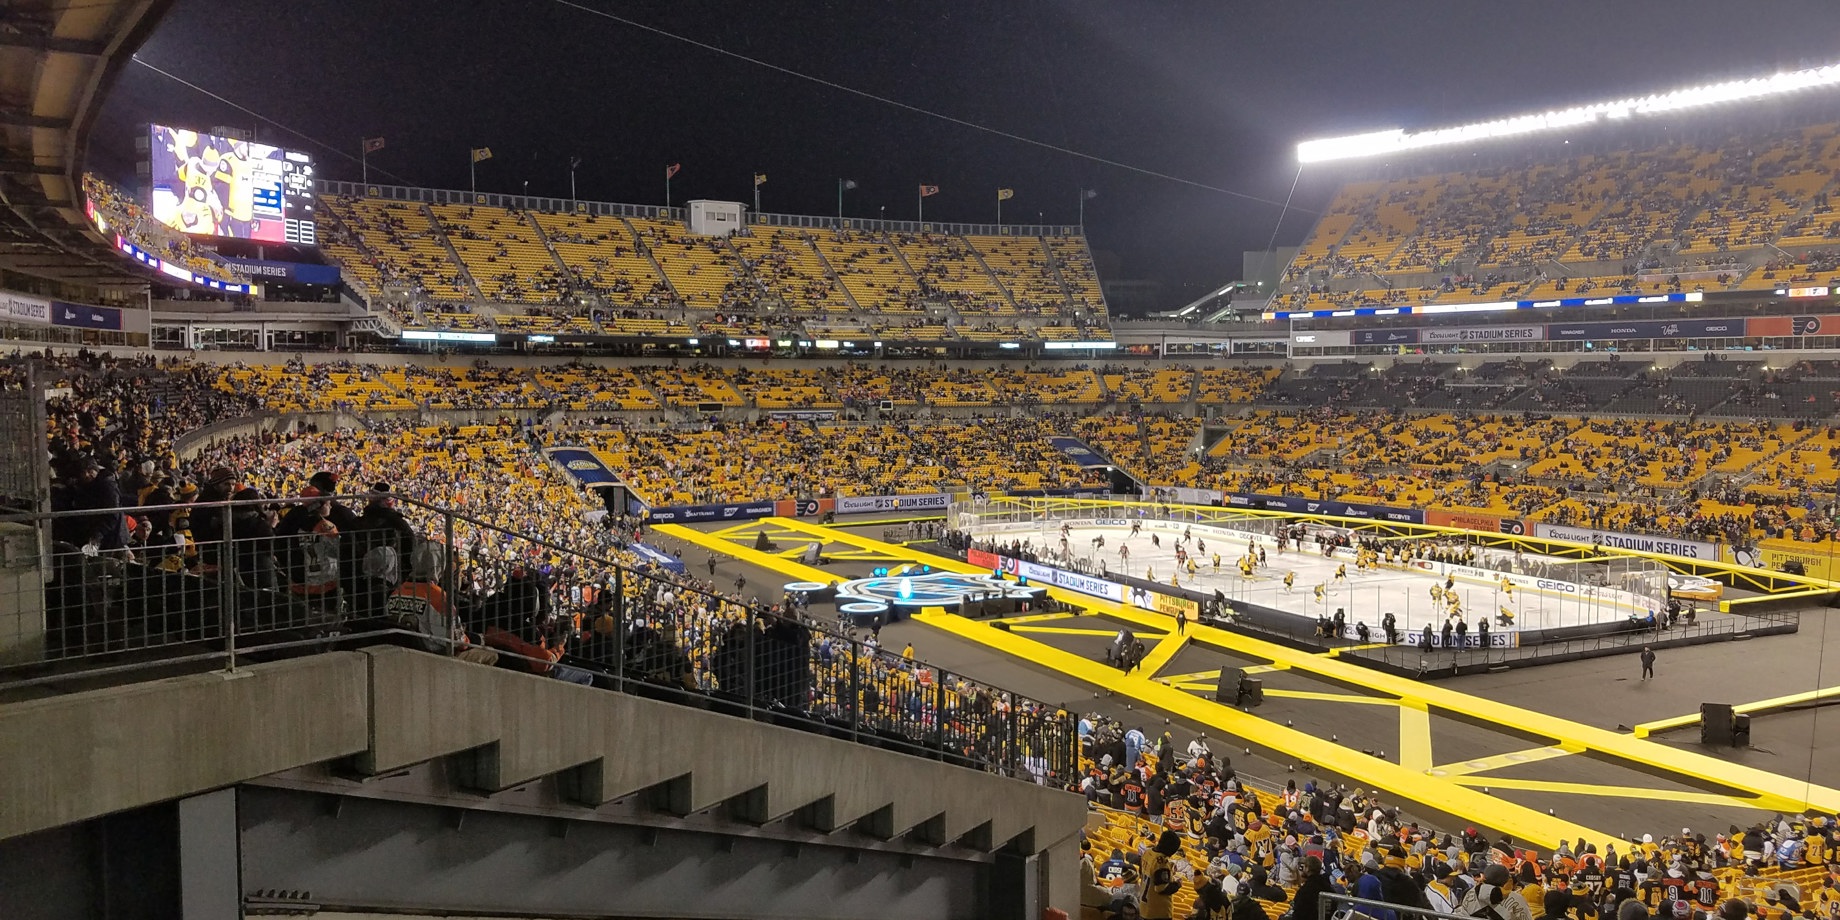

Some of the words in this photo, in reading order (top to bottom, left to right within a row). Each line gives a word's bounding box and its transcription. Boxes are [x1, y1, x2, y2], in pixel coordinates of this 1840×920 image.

[231, 263, 262, 275] STADIUM
[262, 266, 286, 277] SERIES
[12, 301, 31, 316] STADIUM
[30, 304, 45, 318] SERIES
[1469, 330, 1504, 339] STADIUM
[1504, 328, 1533, 338] SERIES
[884, 499, 917, 508] STDIUM
[918, 496, 945, 506] SERIES
[1387, 513, 1411, 521] DISCOVER
[1454, 516, 1494, 526] PHILADELPHIA
[1571, 534, 1590, 542] LIGHT
[1605, 535, 1653, 551] STADIUM
[1656, 541, 1697, 558] SERIES
[1771, 553, 1822, 566] PITTSBURGH
[1771, 561, 1809, 573] PENS
[1058, 573, 1085, 590] STADIUM
[1085, 581, 1109, 595] SERIES
[1537, 579, 1575, 592] GEICO
[1159, 594, 1195, 610] PITTSBURGH
[1466, 634, 1506, 646] SEIES
[1668, 885, 1679, 902] 9
[1699, 887, 1713, 904] 11
